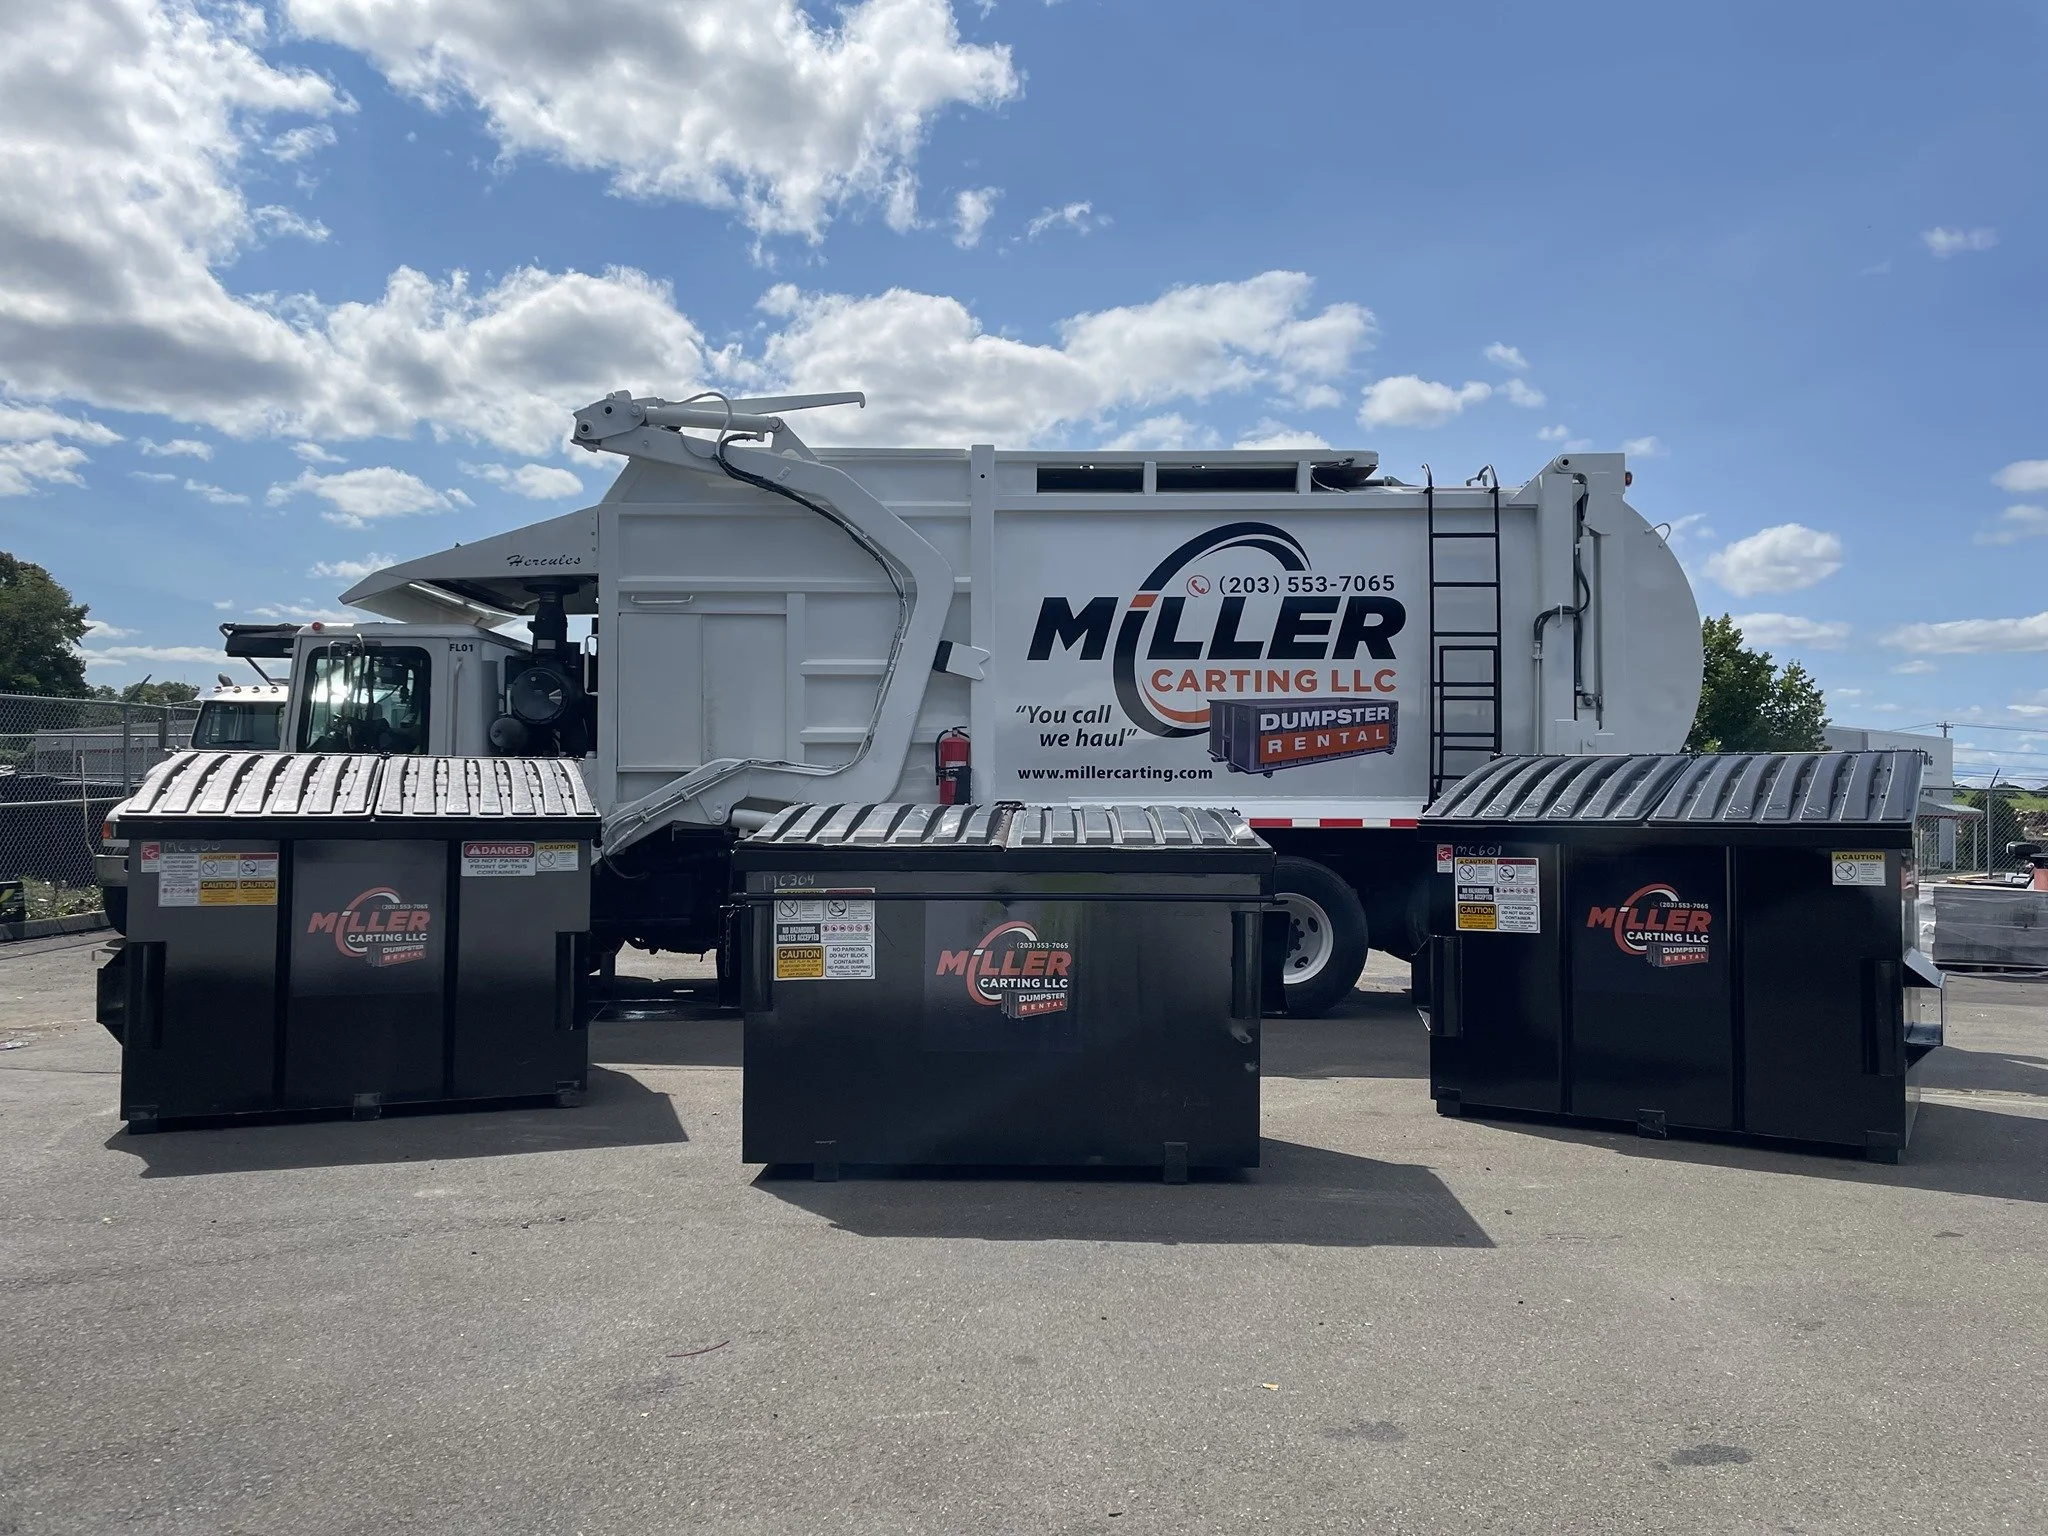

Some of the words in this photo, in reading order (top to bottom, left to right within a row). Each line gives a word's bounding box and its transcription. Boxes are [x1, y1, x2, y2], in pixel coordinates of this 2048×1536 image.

[506, 554, 582, 567] Hercules
[1218, 575, 1281, 595] (203)
[1287, 575, 1395, 594] 553-7065
[450, 644, 474, 652] FL01
[1151, 668, 1317, 693] CARTING
[1330, 669, 1397, 692] LLC
[1072, 704, 1112, 724] call
[1259, 706, 1390, 732] DUMPSTER
[1040, 733, 1070, 747] we
[1268, 728, 1384, 754] RENTAL
[1018, 765, 1213, 782] www.millercarting.com
[481, 846, 529, 855] DANGER
[1461, 906, 1494, 914] CAUTION
[348, 934, 402, 942] CARTING
[406, 933, 427, 941] LLC
[1627, 931, 1683, 942] CARTING
[1686, 934, 1709, 943] LLC
[383, 945, 424, 953] DUMPSTER
[780, 950, 820, 958] CAUTION
[980, 978, 1040, 988] CARTING
[1044, 979, 1069, 988] LLC
[1019, 993, 1065, 1002] DUMPSTER
[1022, 1001, 1064, 1011] RENTAL
